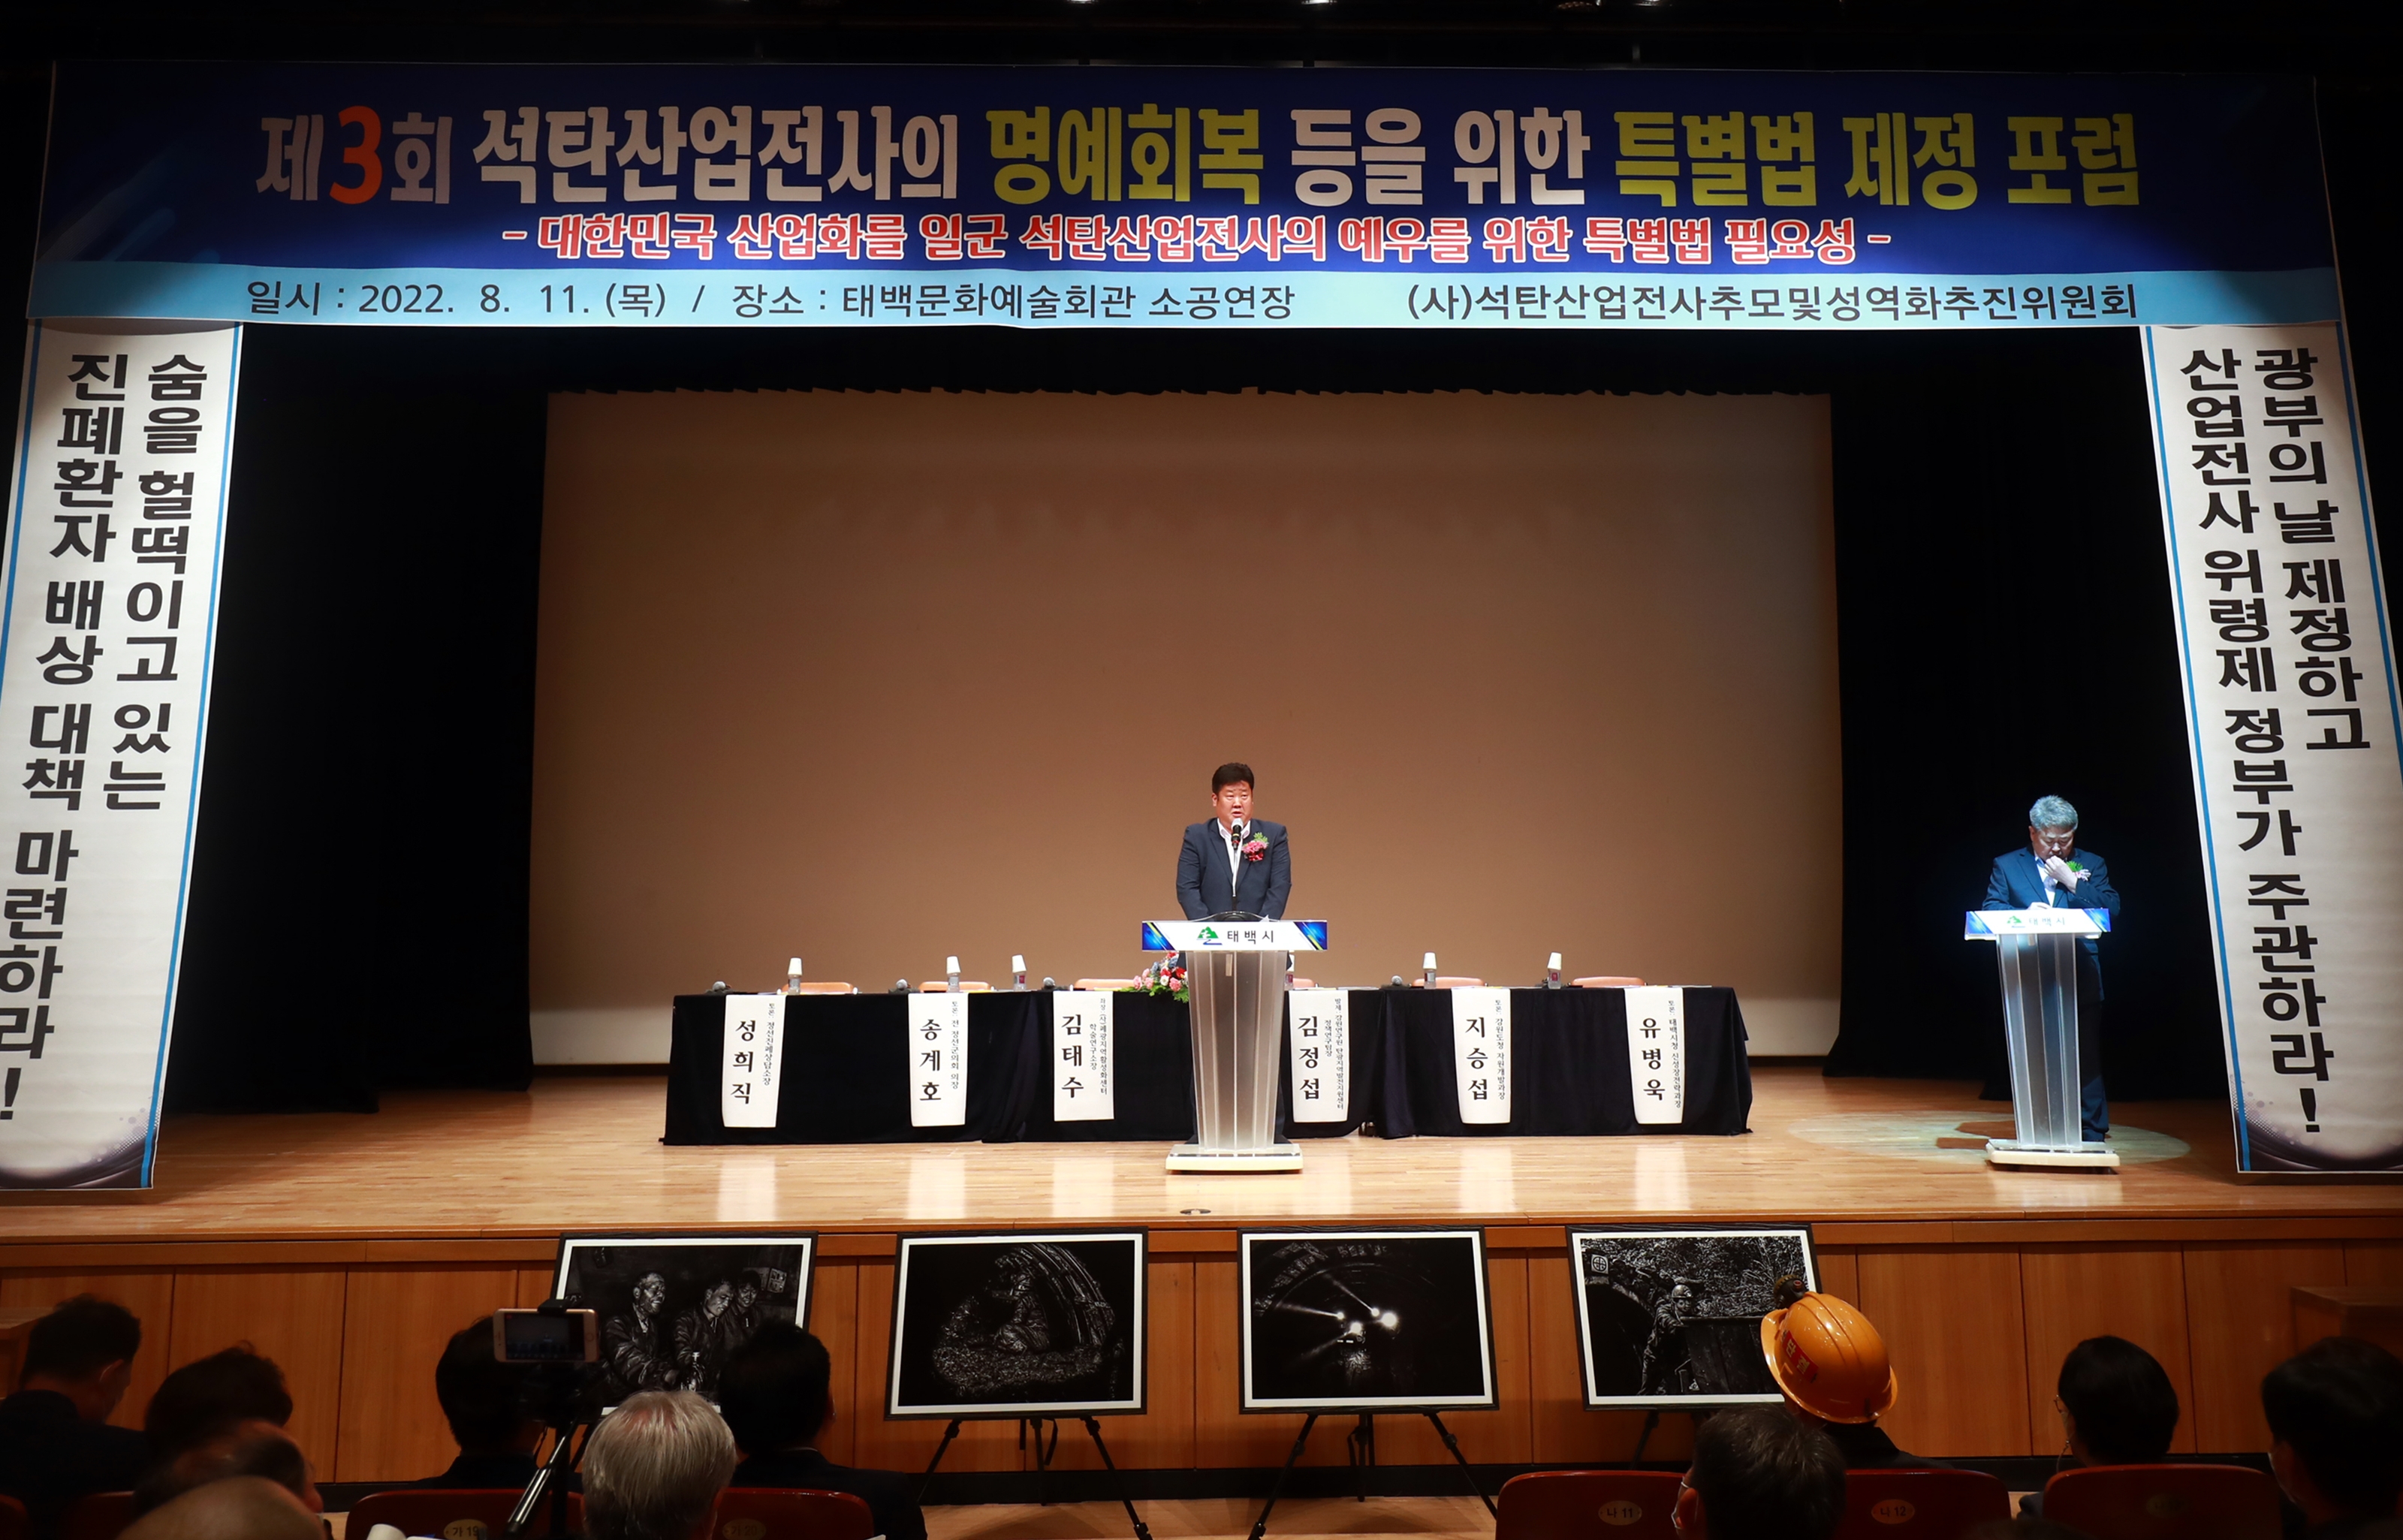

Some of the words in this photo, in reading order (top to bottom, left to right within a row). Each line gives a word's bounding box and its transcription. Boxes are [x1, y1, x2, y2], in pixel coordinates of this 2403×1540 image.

[256, 105, 452, 205] 제3회
[473, 105, 958, 204] 석탄산업전사의
[985, 103, 1265, 205] 명예회복
[1291, 107, 1427, 206] 등을
[1454, 107, 1591, 206] 위한
[1614, 111, 1817, 207] 특별법
[1843, 113, 1978, 210] 제정
[2007, 113, 2140, 207] 포럼
[538, 212, 718, 261] 대한민국
[727, 212, 908, 261] 산업화를
[919, 213, 1009, 261] 일군
[1018, 213, 1327, 262] 석탄산업전사의
[1337, 215, 1473, 263] 예우를
[1482, 215, 1574, 264] 위한
[1583, 217, 1712, 264] 특별법
[1724, 218, 1856, 265] 필요성
[247, 280, 321, 316] 일시
[359, 284, 454, 313] 2022.
[480, 284, 510, 312] 8.
[541, 285, 589, 313] 11.
[606, 283, 665, 318] (목)
[733, 284, 804, 318] 장소
[843, 282, 1136, 319] 태백문화예술회관
[1149, 285, 1296, 320] 소공연장
[1409, 283, 2137, 321] (사)석탄산업전사추모및성역화추진위원회
[143, 354, 207, 454] 숨을
[2180, 348, 2260, 534] 산업전사
[2254, 348, 2328, 485] 광부의
[49, 354, 128, 562] 진폐환자
[2273, 499, 2339, 544] 날
[116, 471, 194, 682] 헐떡이고
[2204, 549, 2278, 692] 위령제
[36, 580, 104, 685] 배상
[2281, 559, 2371, 750] 제정하고
[22, 703, 92, 811] 대책
[104, 703, 172, 810] 있는
[2224, 708, 2302, 856] 정부가
[0, 829, 79, 1120] 마련하라!
[2247, 874, 2335, 1132] 주관하라!
[730, 1019, 756, 1105] 성희직
[919, 1018, 942, 1102] 송계호
[1061, 1014, 1084, 1098] 김태수
[1298, 1015, 1320, 1100] 김정섭
[1465, 1017, 1488, 1101] 지승섭
[1639, 1017, 1666, 1101] 유병욱
[453, 1526, 463, 1537] 가
[1607, 1508, 1617, 1518] 나
[1621, 1507, 1633, 1517] 11
[1894, 1506, 1906, 1517] 12
